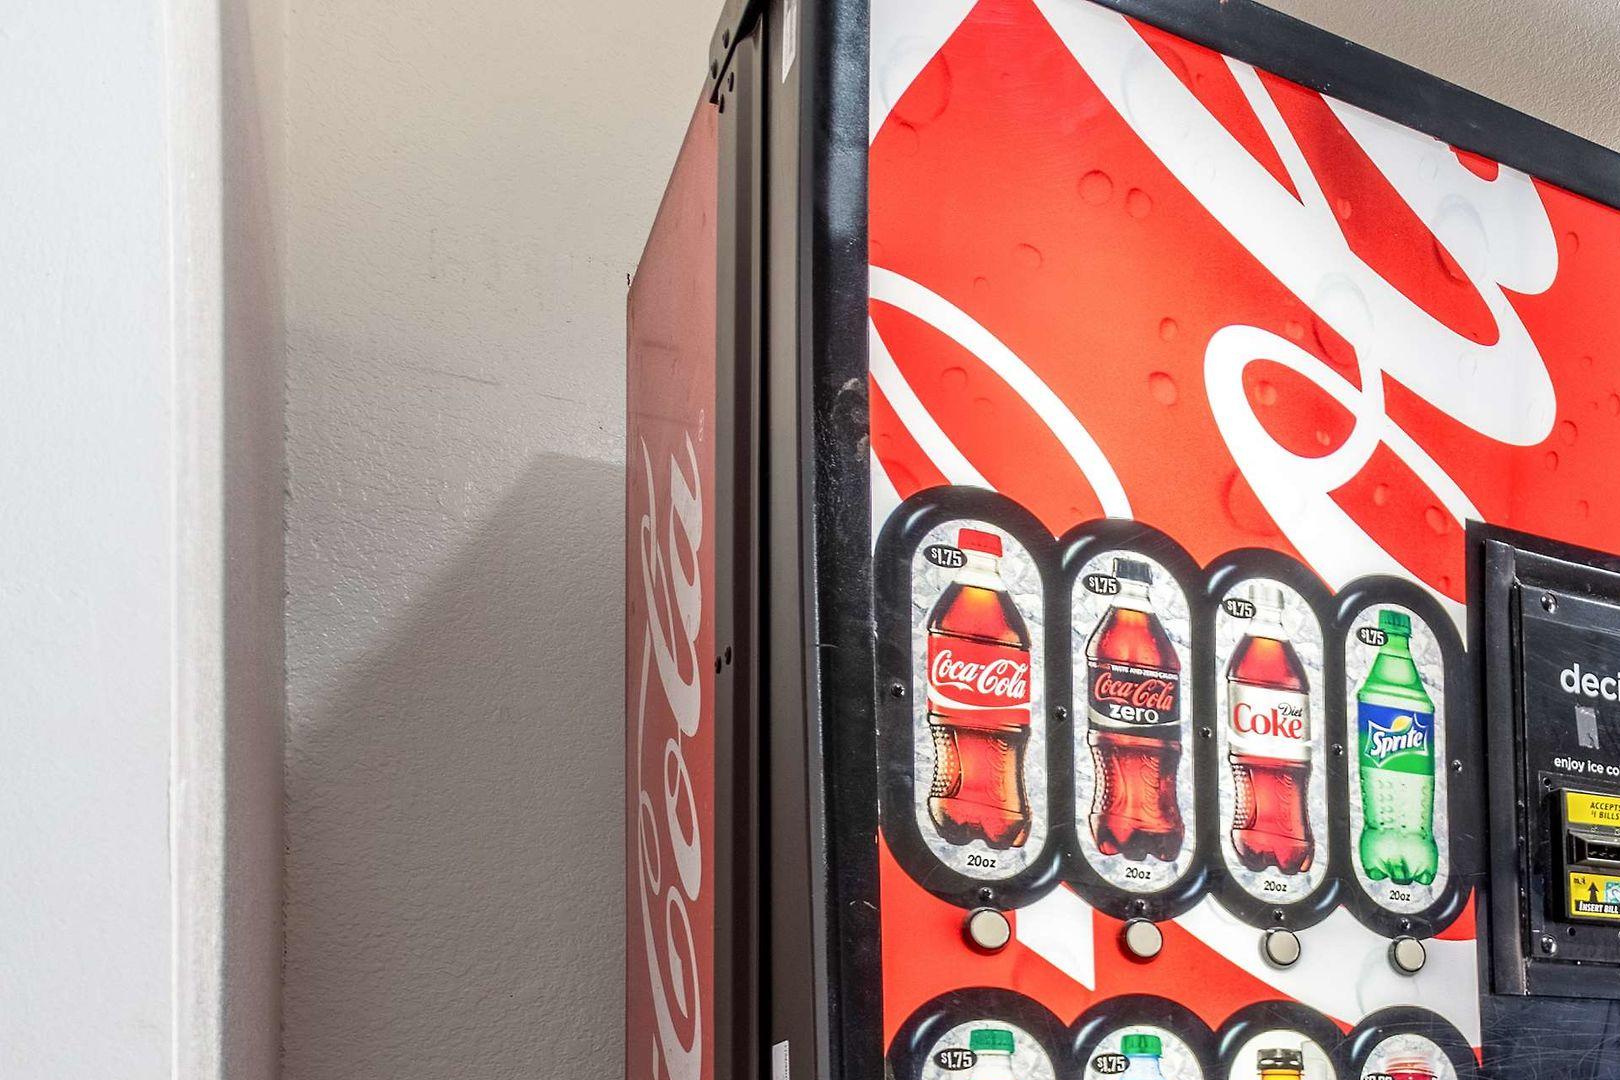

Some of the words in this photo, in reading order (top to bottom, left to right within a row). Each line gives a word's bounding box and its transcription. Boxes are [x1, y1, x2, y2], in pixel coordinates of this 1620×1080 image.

[931, 547, 962, 567] $1.75
[1088, 576, 1117, 593] $1.75
[1227, 601, 1253, 618] $1.75
[1361, 630, 1385, 645] $1.75
[932, 650, 1028, 698] Coca-Cola
[1095, 672, 1174, 711] Coca-Cola
[1109, 704, 1159, 723] zero
[1278, 703, 1302, 717] Diet
[1233, 703, 1302, 740] Coke
[1371, 729, 1423, 759] Sprite
[1554, 756, 1585, 776] enjoy
[1587, 760, 1604, 774] ice
[1600, 811, 1620, 820] BILLS
[966, 854, 996, 869] 20oz
[1125, 867, 1151, 880] 20oz
[1264, 880, 1288, 893] 20oz
[1389, 890, 1411, 902] 20oz
[1579, 901, 1603, 912] INSERT
[1604, 904, 1618, 914] BILL
[941, 1054, 973, 1068] $1.75
[1097, 1057, 1125, 1073] $1.75
